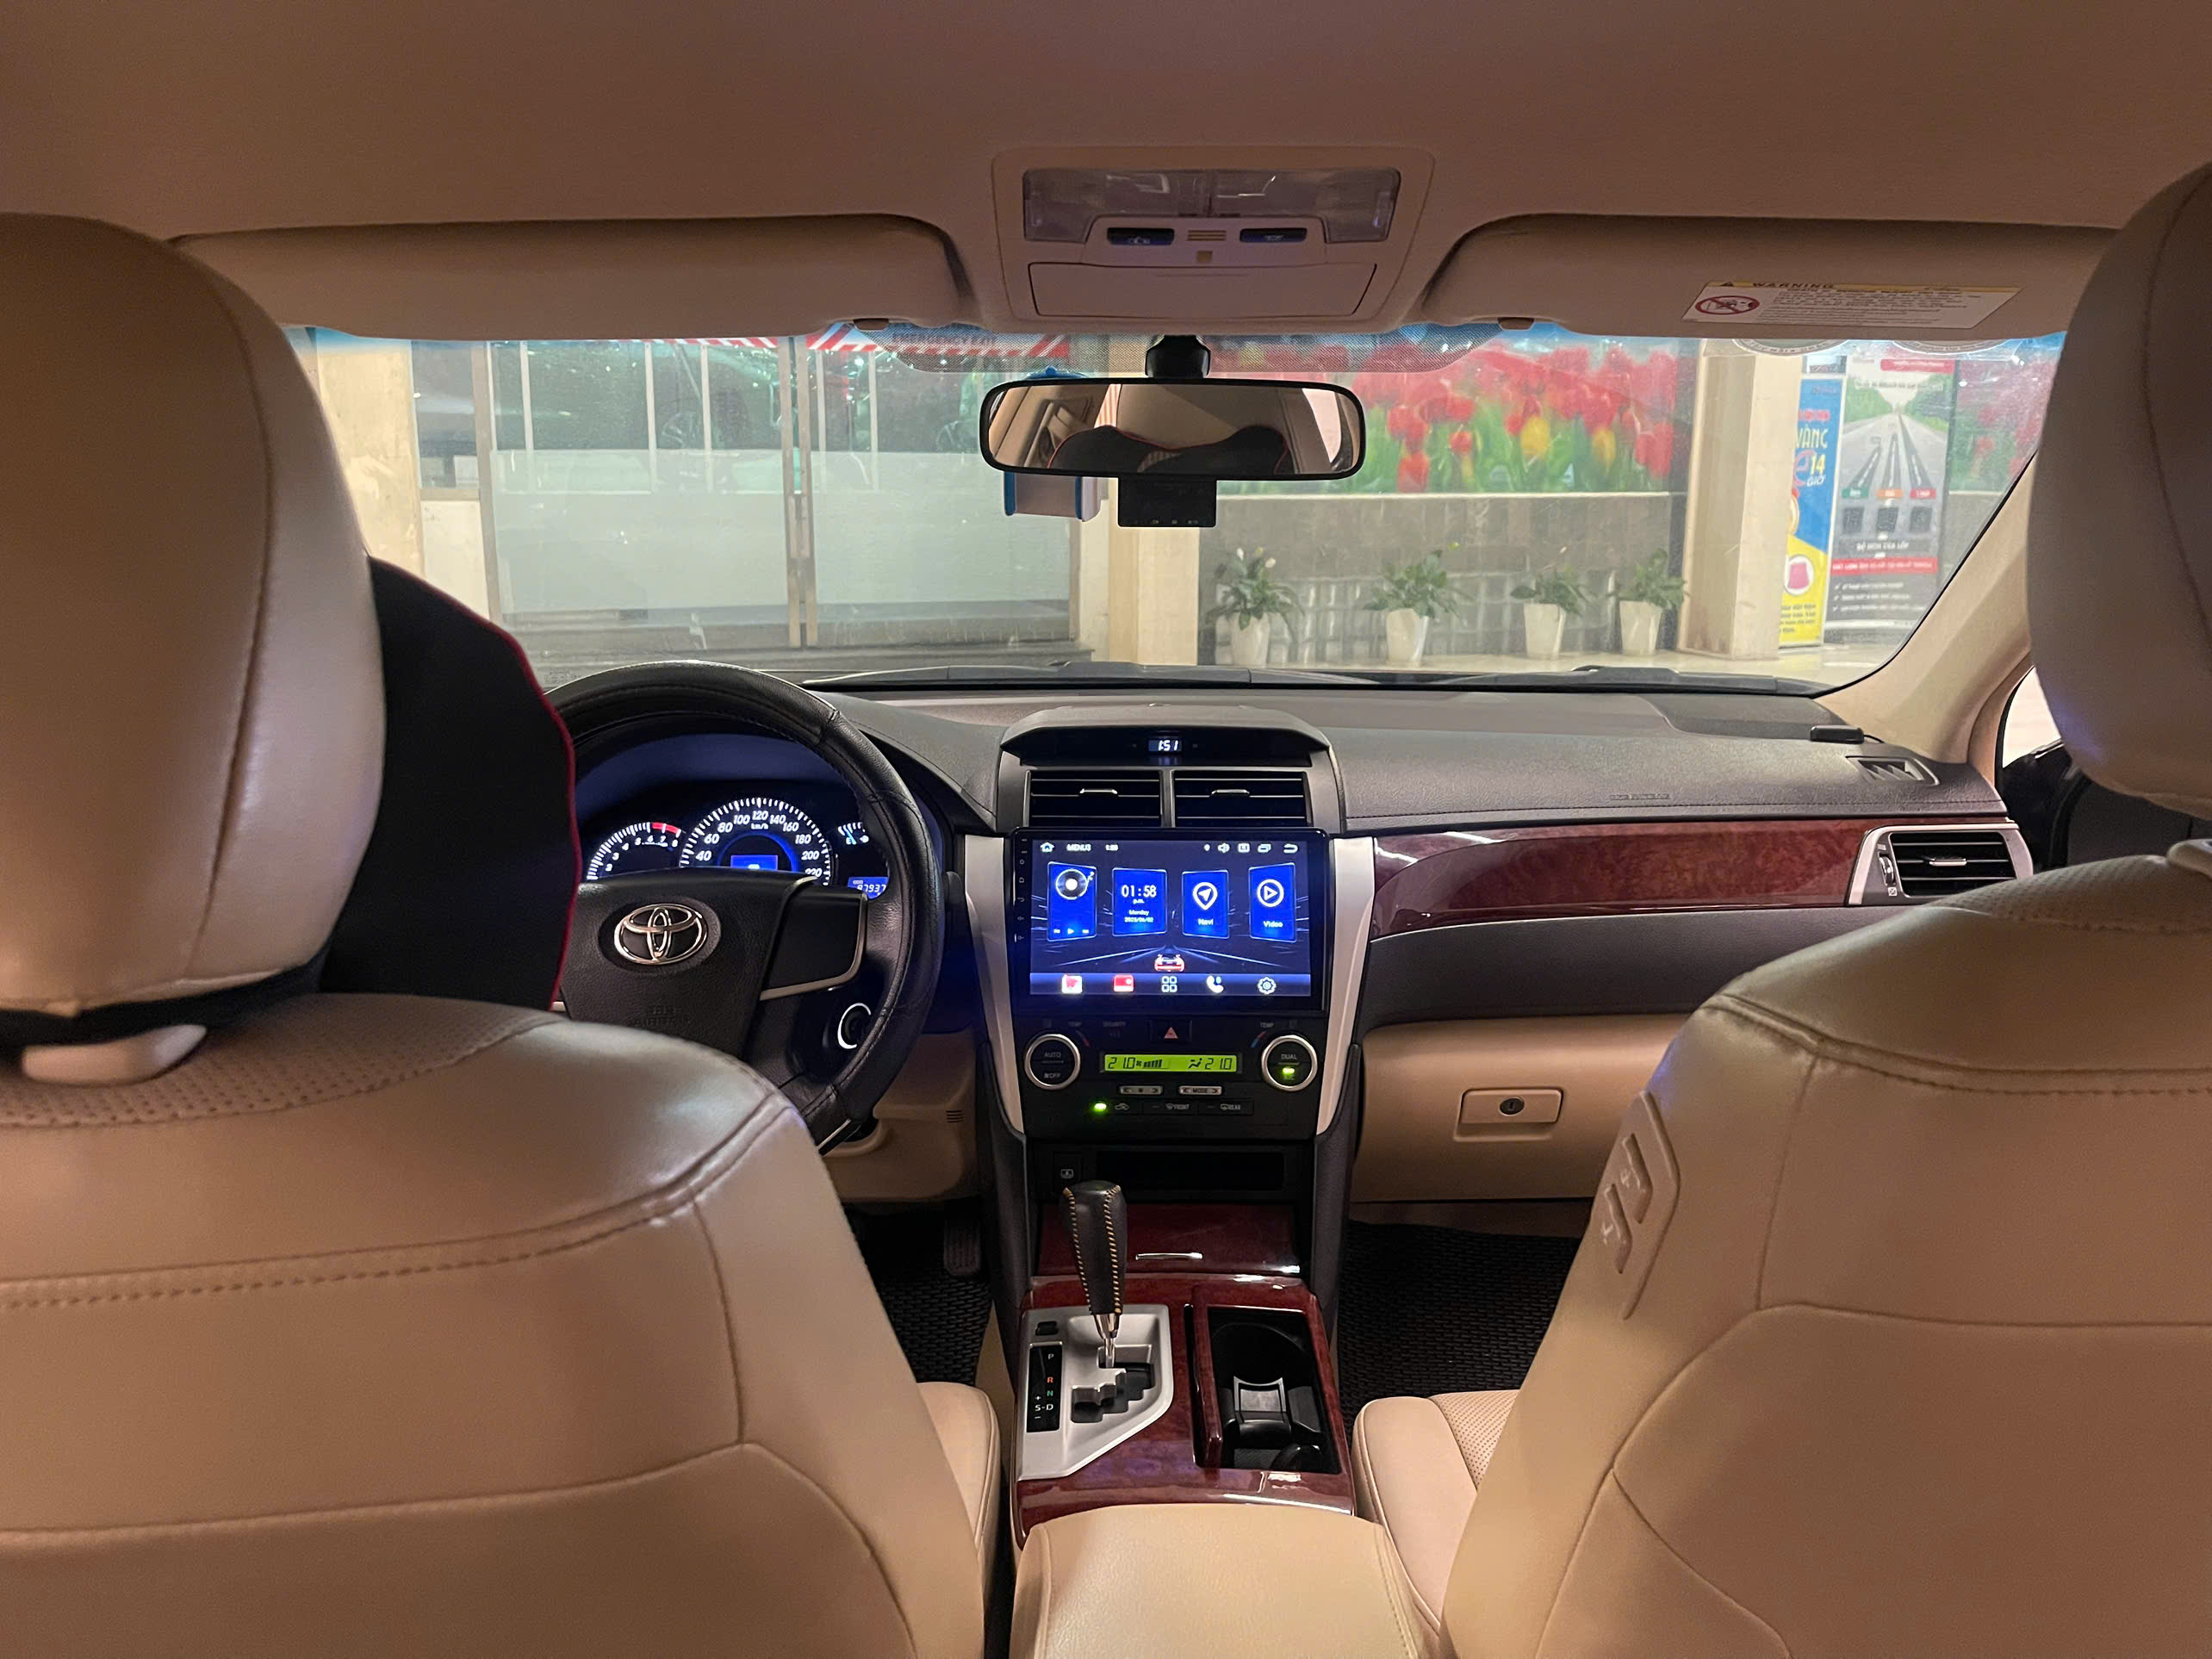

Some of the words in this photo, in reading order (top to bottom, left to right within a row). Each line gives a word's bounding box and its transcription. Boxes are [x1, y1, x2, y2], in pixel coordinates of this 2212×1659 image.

[1158, 740, 1178, 751] 1:51
[733, 814, 750, 824] 100
[752, 811, 768, 821] 120
[769, 814, 786, 824] 140
[717, 822, 733, 833] 80
[782, 822, 798, 832] 160
[635, 837, 641, 846] 5
[704, 833, 720, 844] 60
[795, 834, 811, 844] 180
[612, 852, 619, 861] 3
[695, 850, 712, 861] 40
[801, 851, 819, 861] 200
[605, 863, 612, 872] 2
[1121, 885, 1157, 898] 01:58
